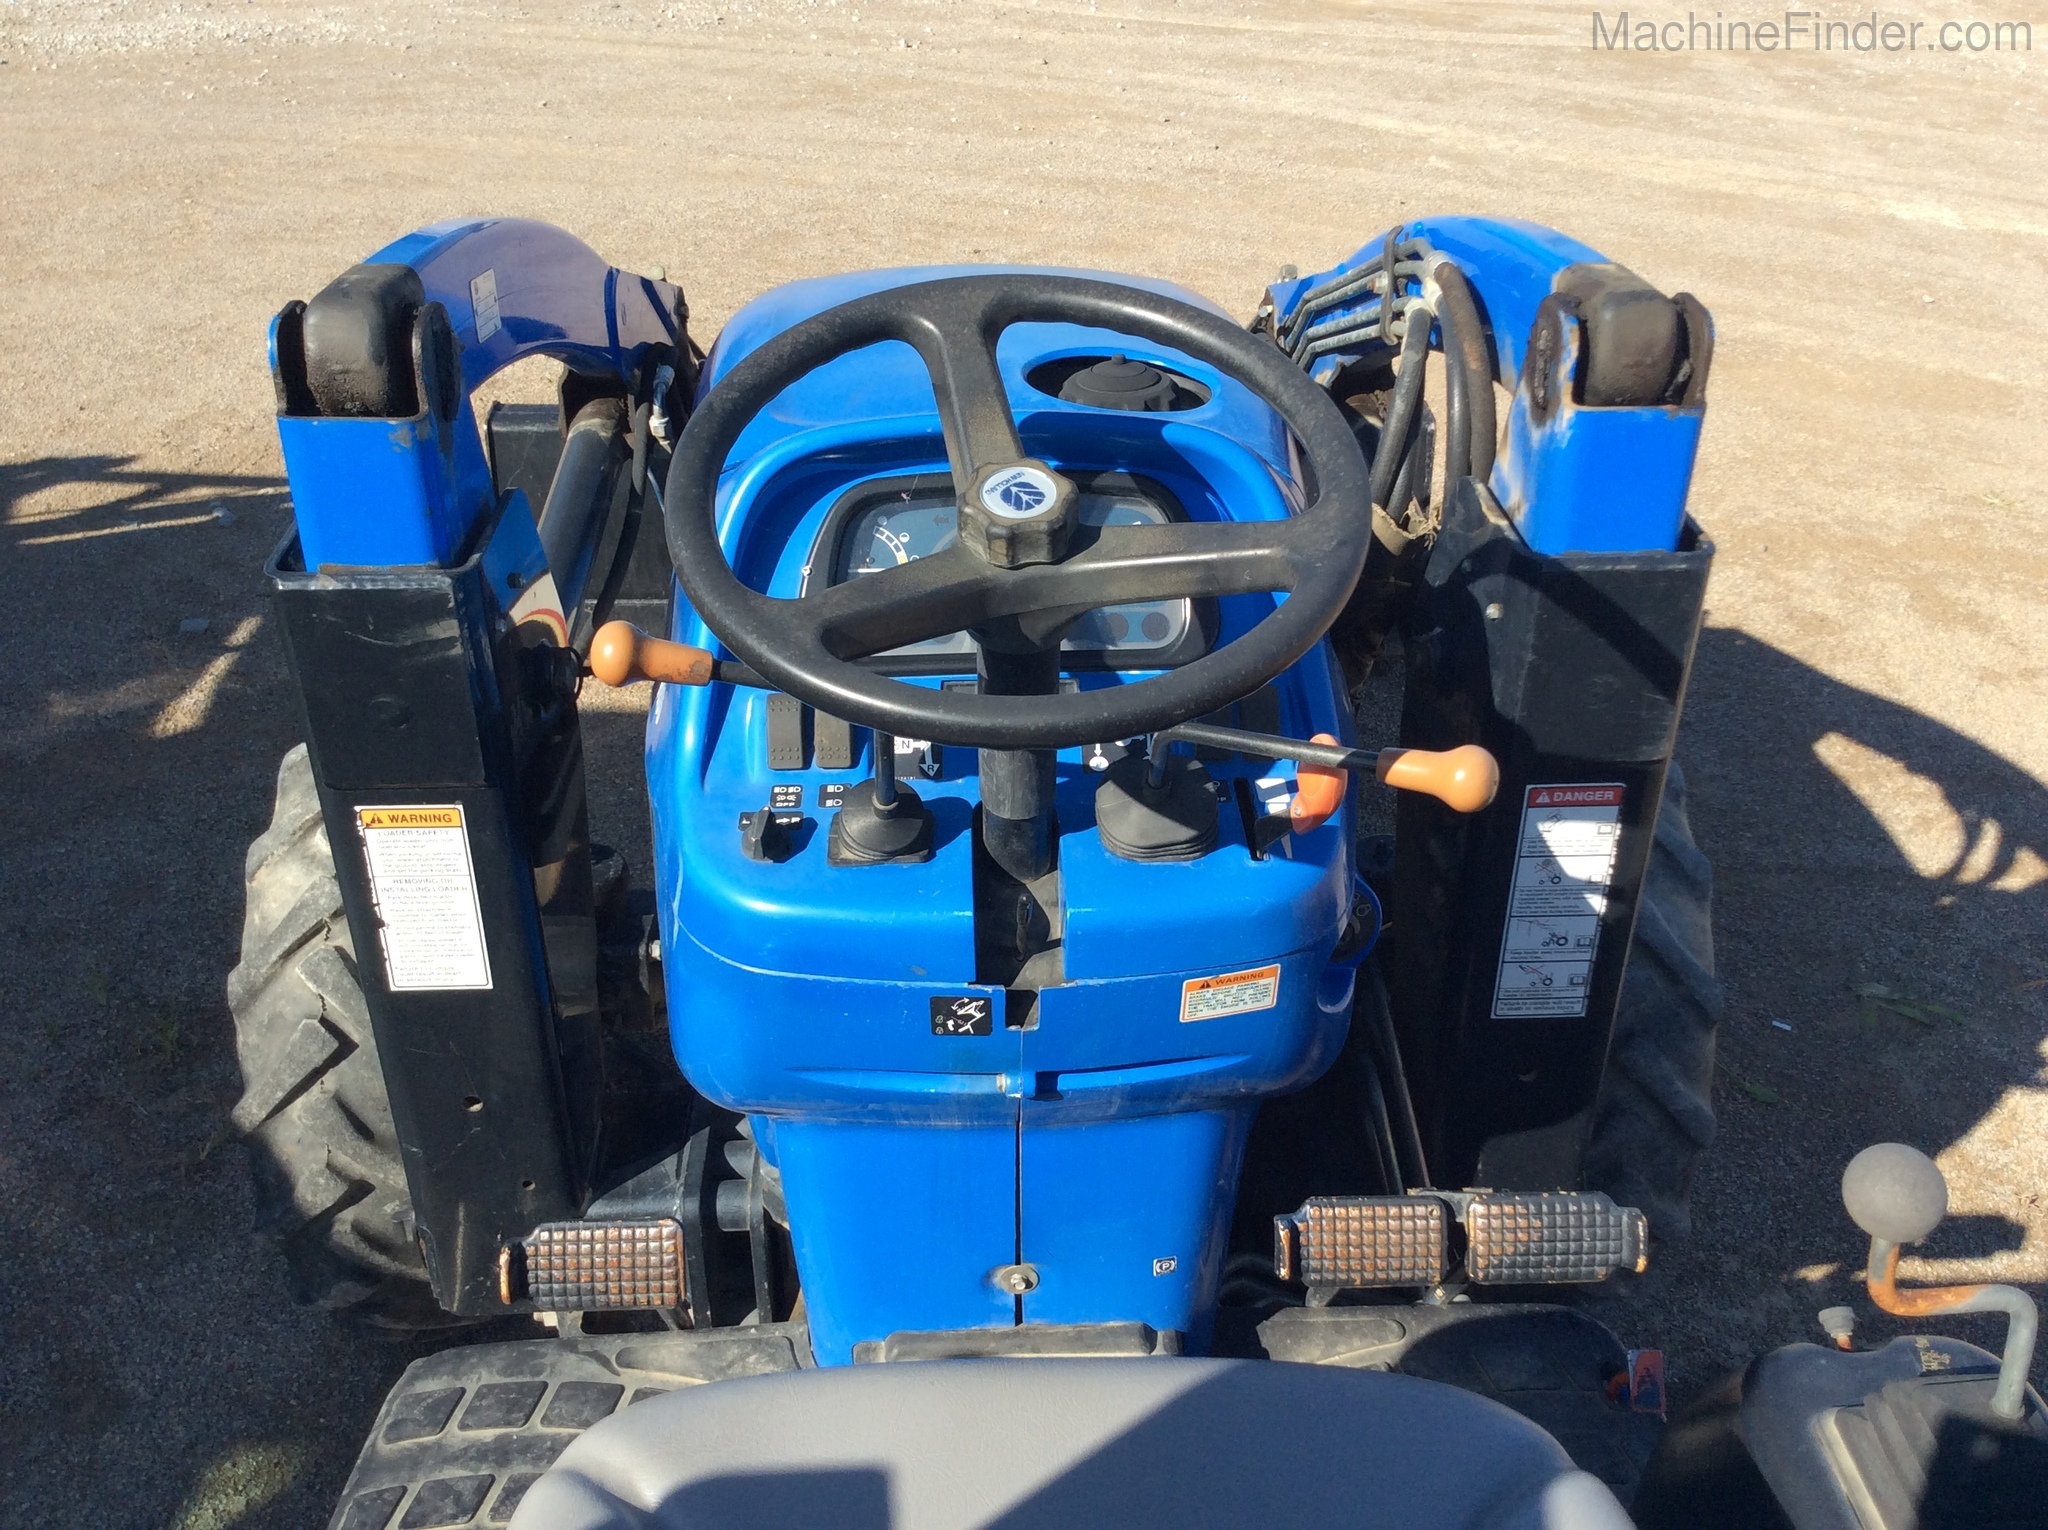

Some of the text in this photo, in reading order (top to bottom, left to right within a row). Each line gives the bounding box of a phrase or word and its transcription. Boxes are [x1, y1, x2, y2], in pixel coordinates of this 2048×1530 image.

[902, 740, 910, 749] N
[927, 764, 935, 772] R
[1553, 791, 1614, 802] DANGER
[387, 813, 452, 823] WARNING
[1215, 971, 1264, 985] WARNING
[1162, 1262, 1170, 1270] P
